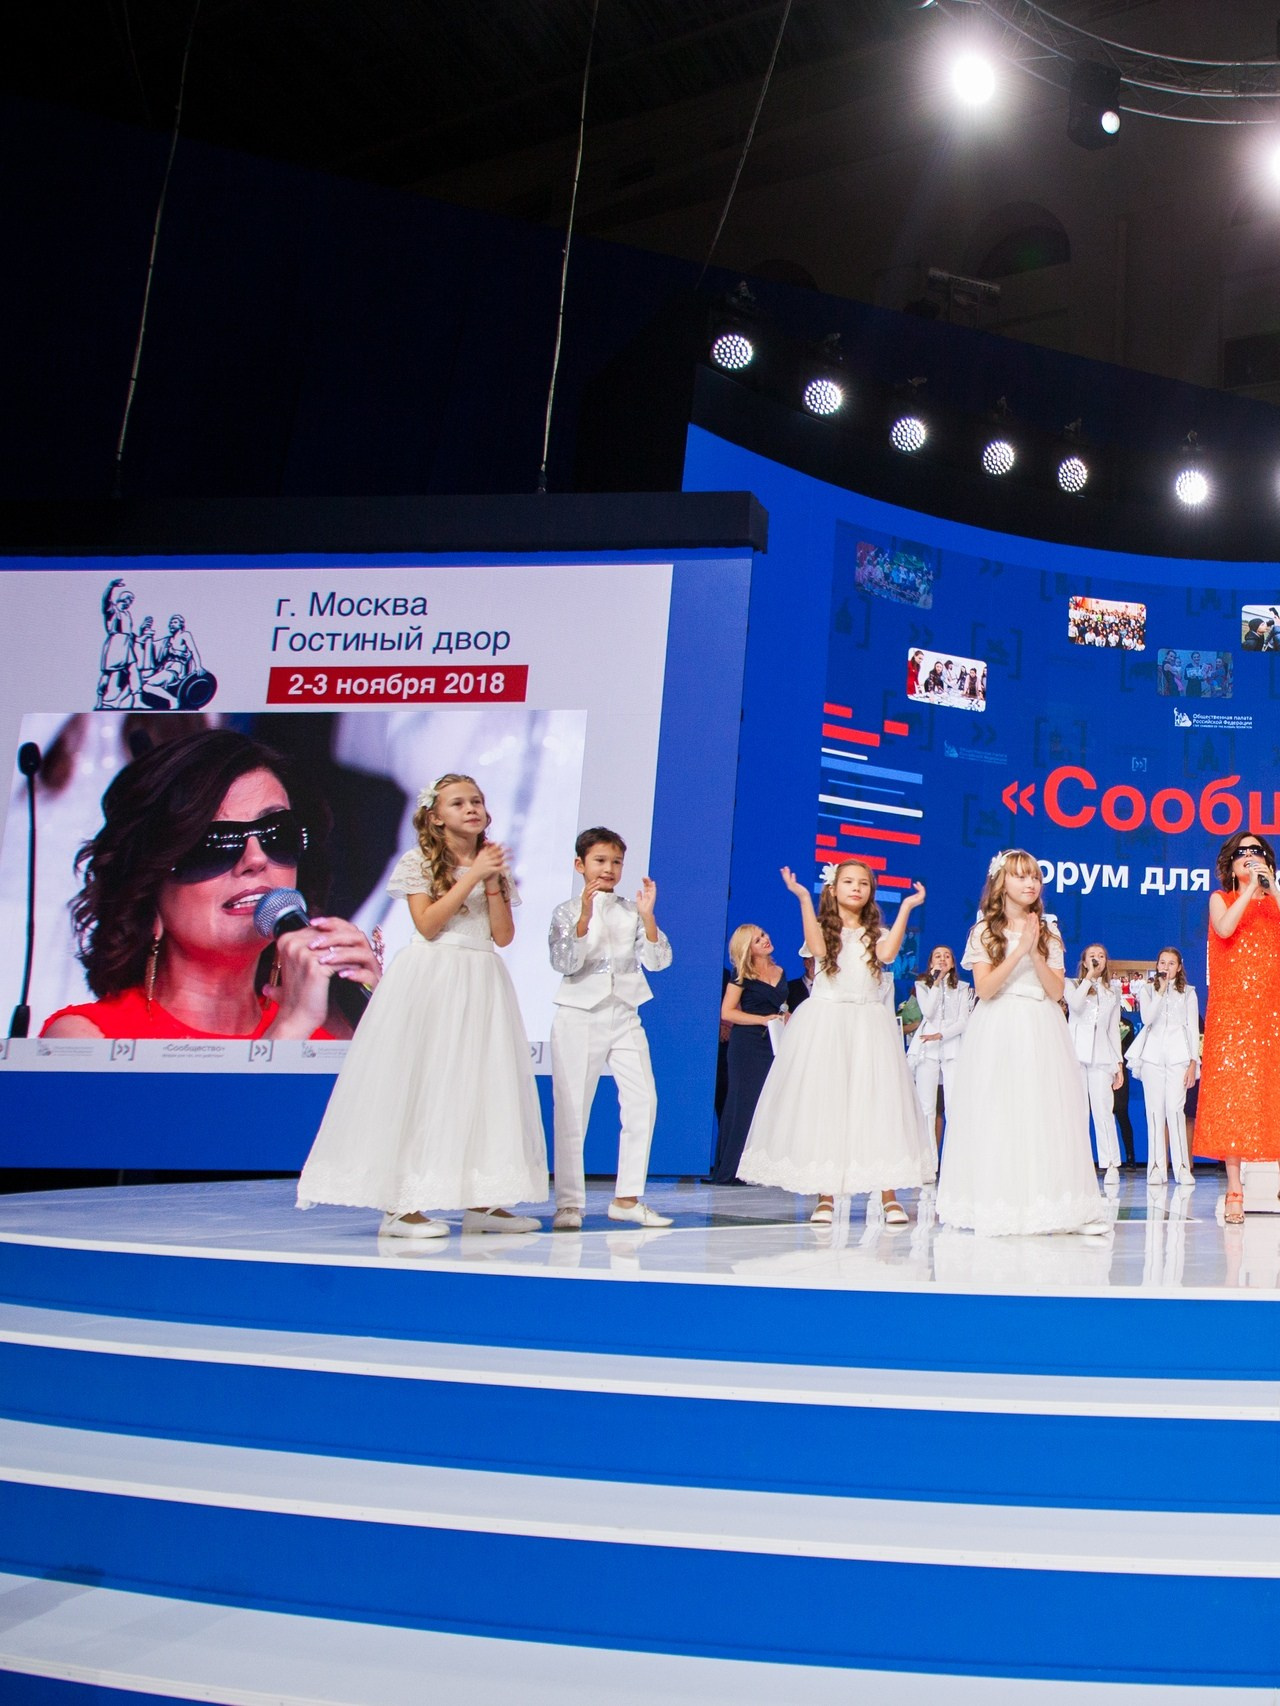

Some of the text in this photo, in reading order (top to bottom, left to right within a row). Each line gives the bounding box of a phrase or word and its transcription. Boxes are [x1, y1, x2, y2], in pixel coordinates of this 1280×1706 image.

[275, 591, 428, 617] г. Москва
[271, 626, 511, 656] Гостиный двор
[288, 672, 505, 700] 2-3 ноября 2018
[1036, 859, 1129, 894] орум
[1140, 866, 1210, 896] для
